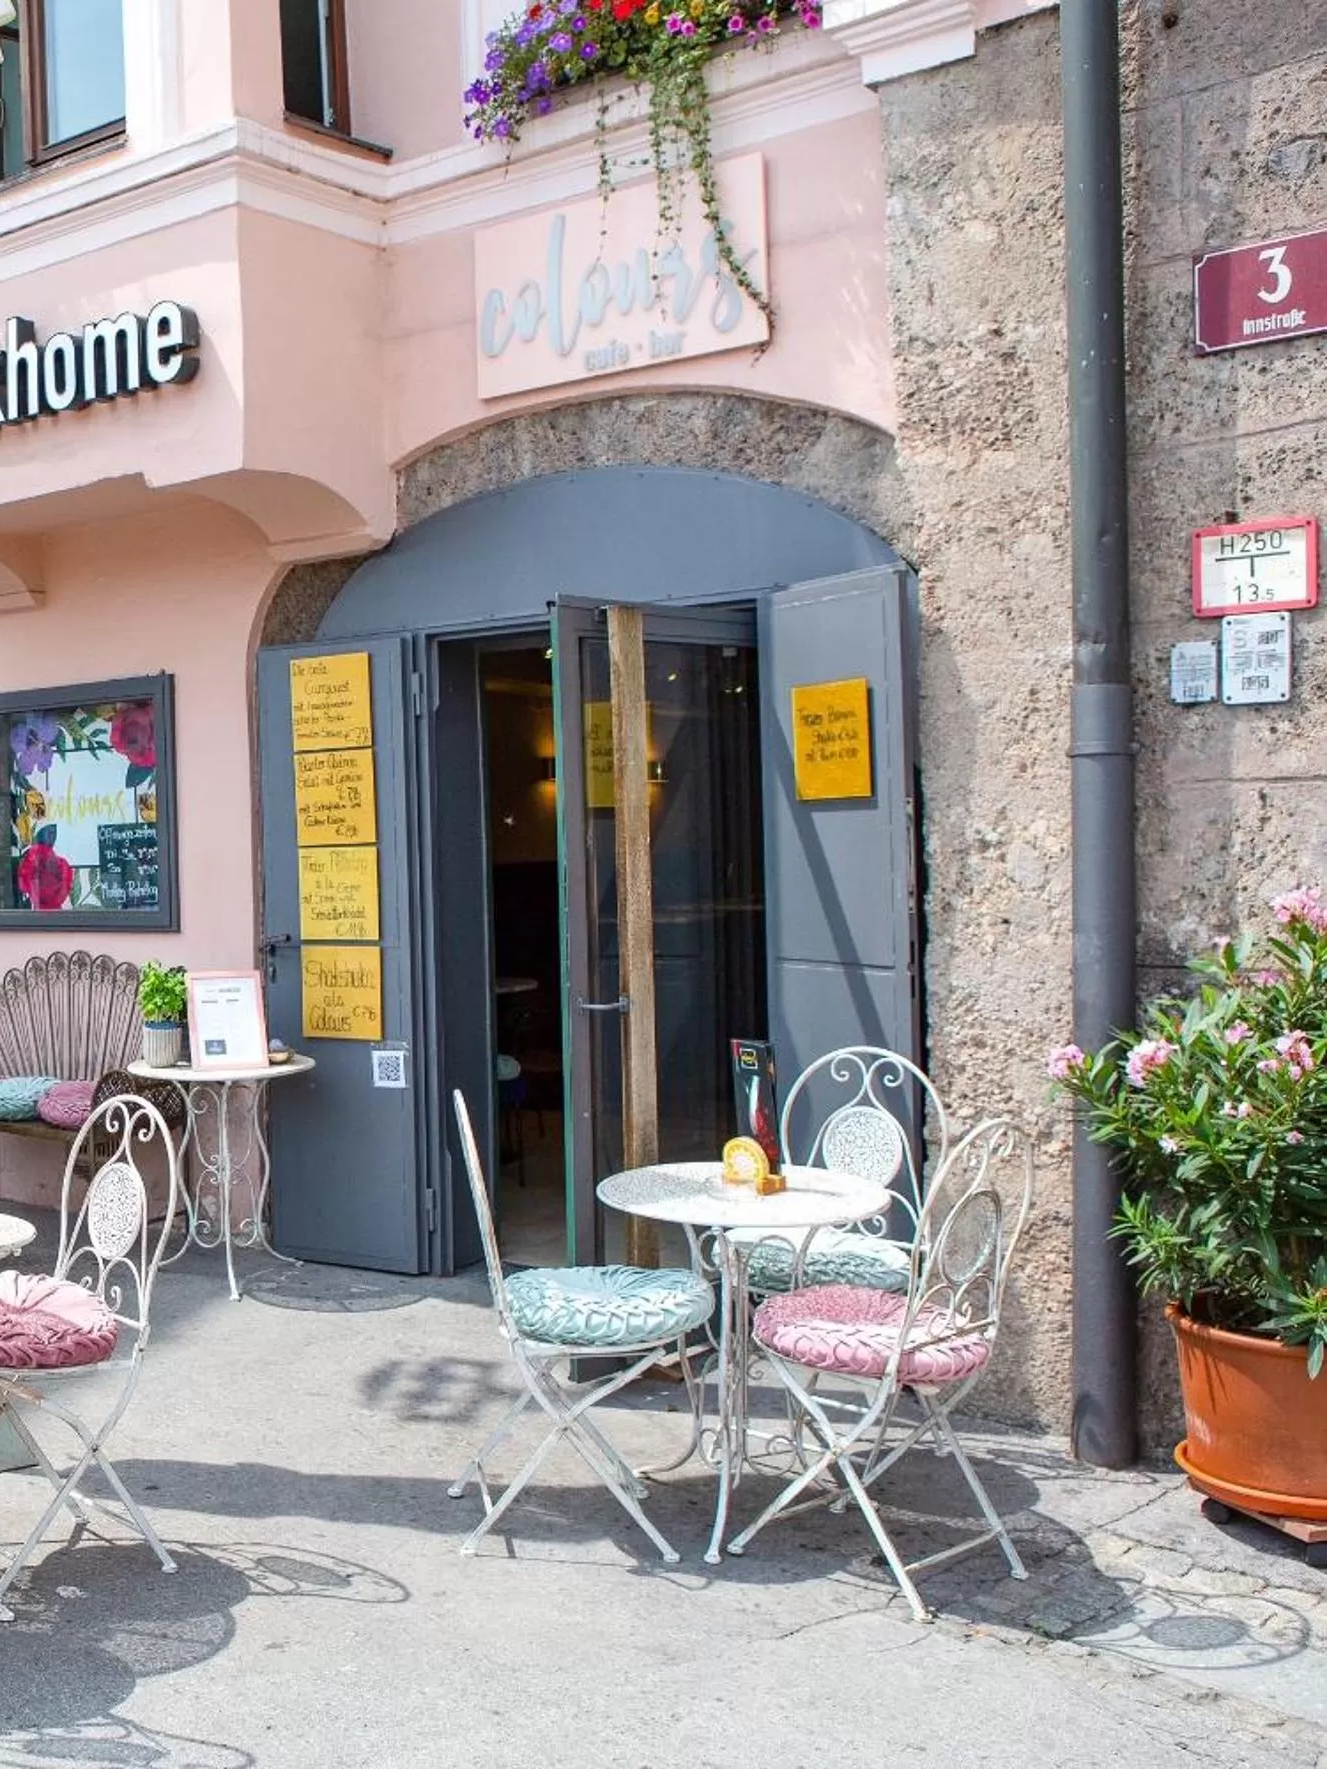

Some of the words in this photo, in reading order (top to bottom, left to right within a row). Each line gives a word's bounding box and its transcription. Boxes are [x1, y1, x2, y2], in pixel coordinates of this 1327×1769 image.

[480, 213, 759, 358] colours
[1257, 246, 1293, 304] 3
[1219, 530, 1283, 556] H250
